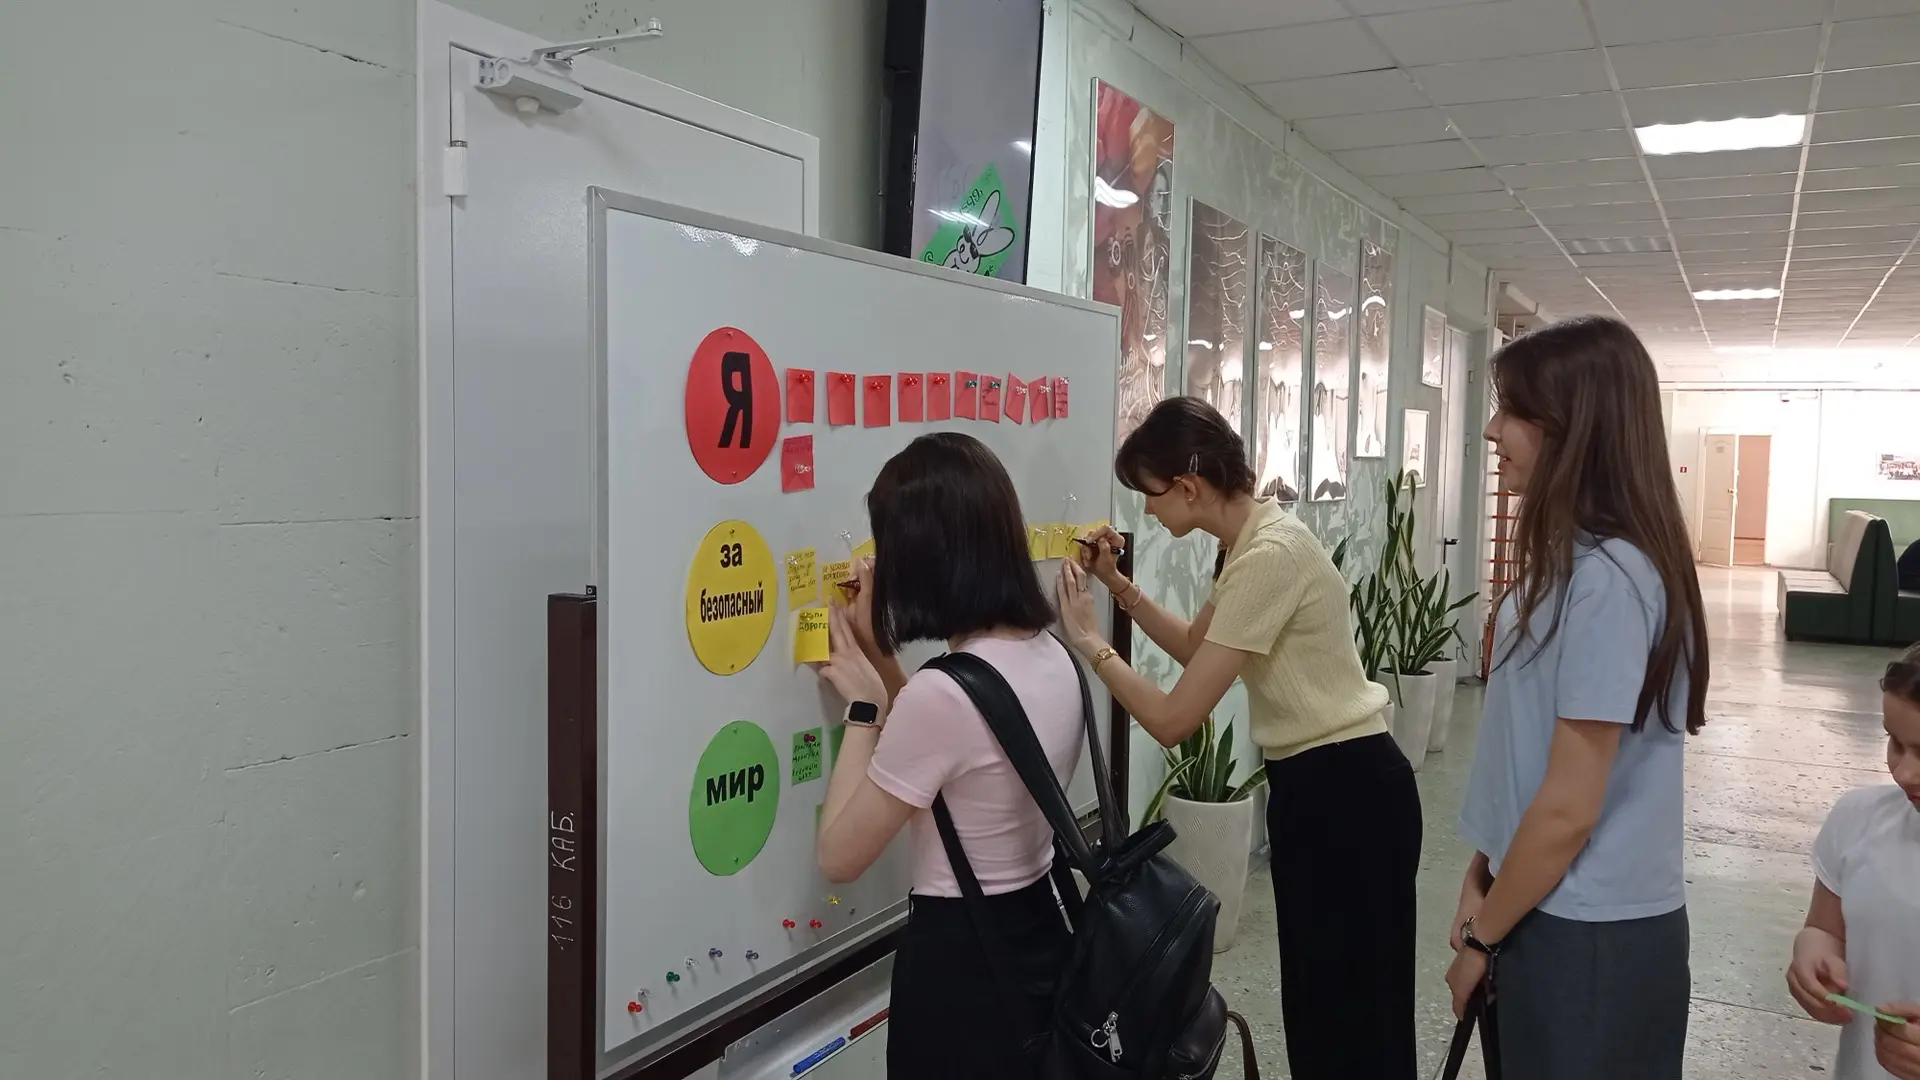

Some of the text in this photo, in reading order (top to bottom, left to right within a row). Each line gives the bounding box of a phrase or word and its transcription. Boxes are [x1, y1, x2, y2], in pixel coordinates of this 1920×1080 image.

[718, 351, 753, 450] Я
[719, 542, 743, 569] за
[700, 580, 764, 624] безопасный
[706, 763, 765, 807] мир
[550, 810, 576, 951] 116 КАБ.
